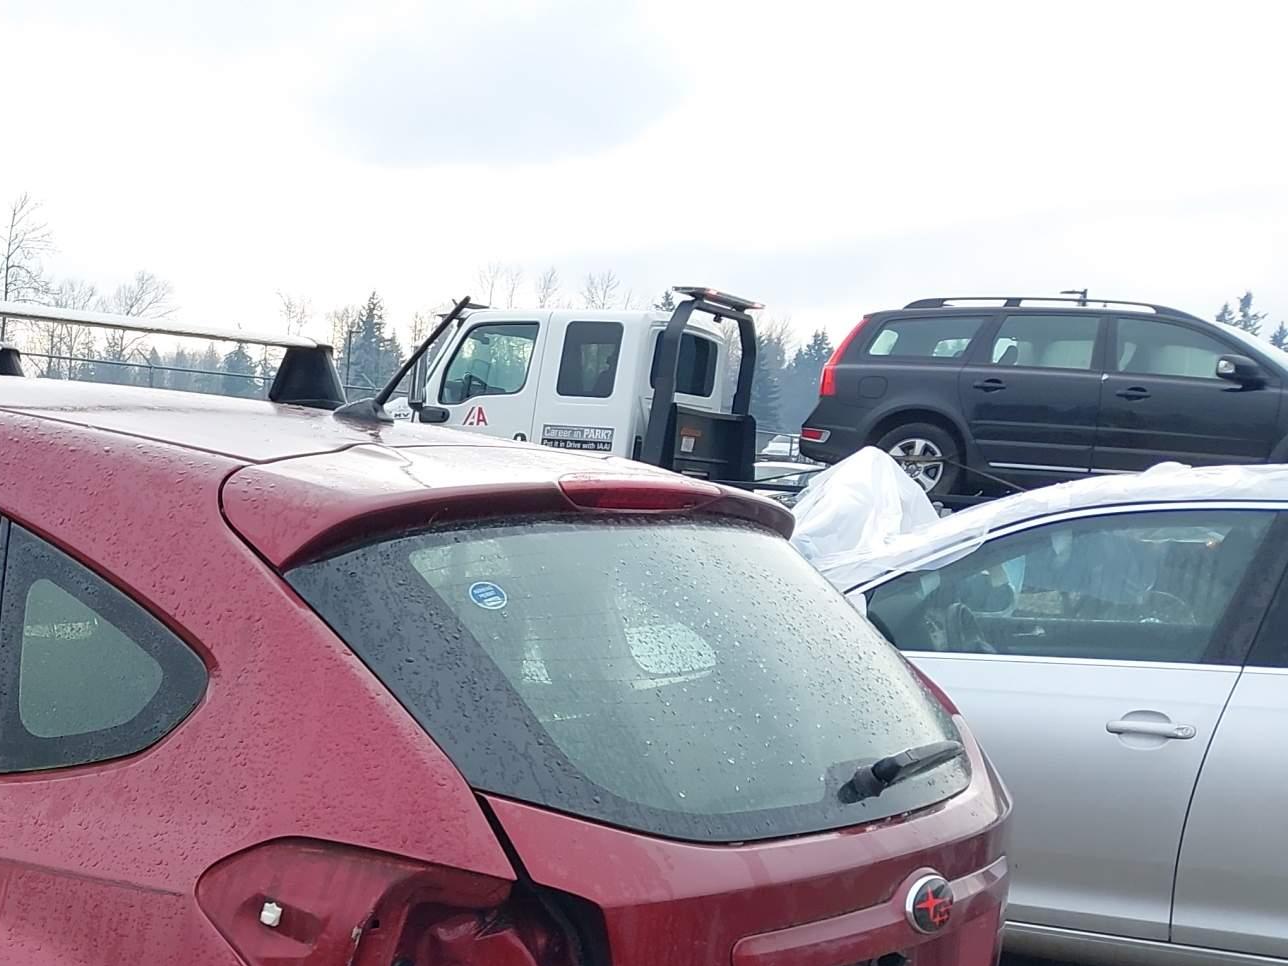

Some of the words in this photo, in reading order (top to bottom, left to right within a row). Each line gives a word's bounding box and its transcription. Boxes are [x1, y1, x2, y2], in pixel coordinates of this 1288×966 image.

[544, 426, 572, 437] Career
[573, 429, 582, 438] in
[583, 428, 612, 440] PARK?
[553, 440, 559, 448] it
[566, 441, 581, 449] Drive
